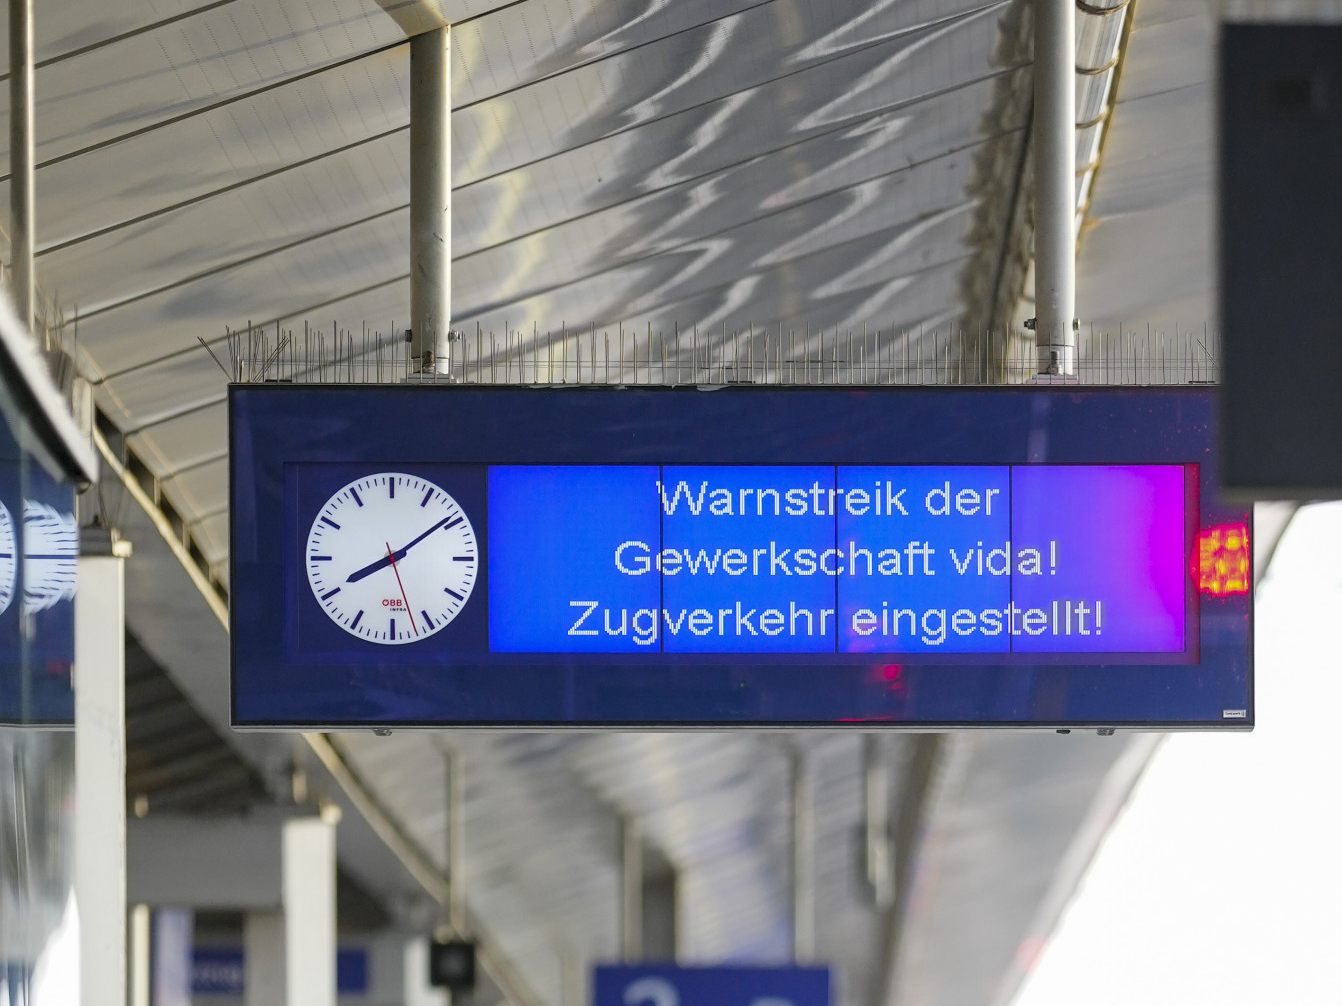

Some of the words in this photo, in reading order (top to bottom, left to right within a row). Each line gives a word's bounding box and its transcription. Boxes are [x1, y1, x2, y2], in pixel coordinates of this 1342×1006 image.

[656, 481, 909, 515] Warnstreik
[925, 481, 1000, 515] der
[614, 541, 936, 575] Gewerkschaft
[949, 541, 1056, 575] vida!
[568, 601, 835, 645] Zugverkehr
[852, 601, 1102, 645] eingestellt!
